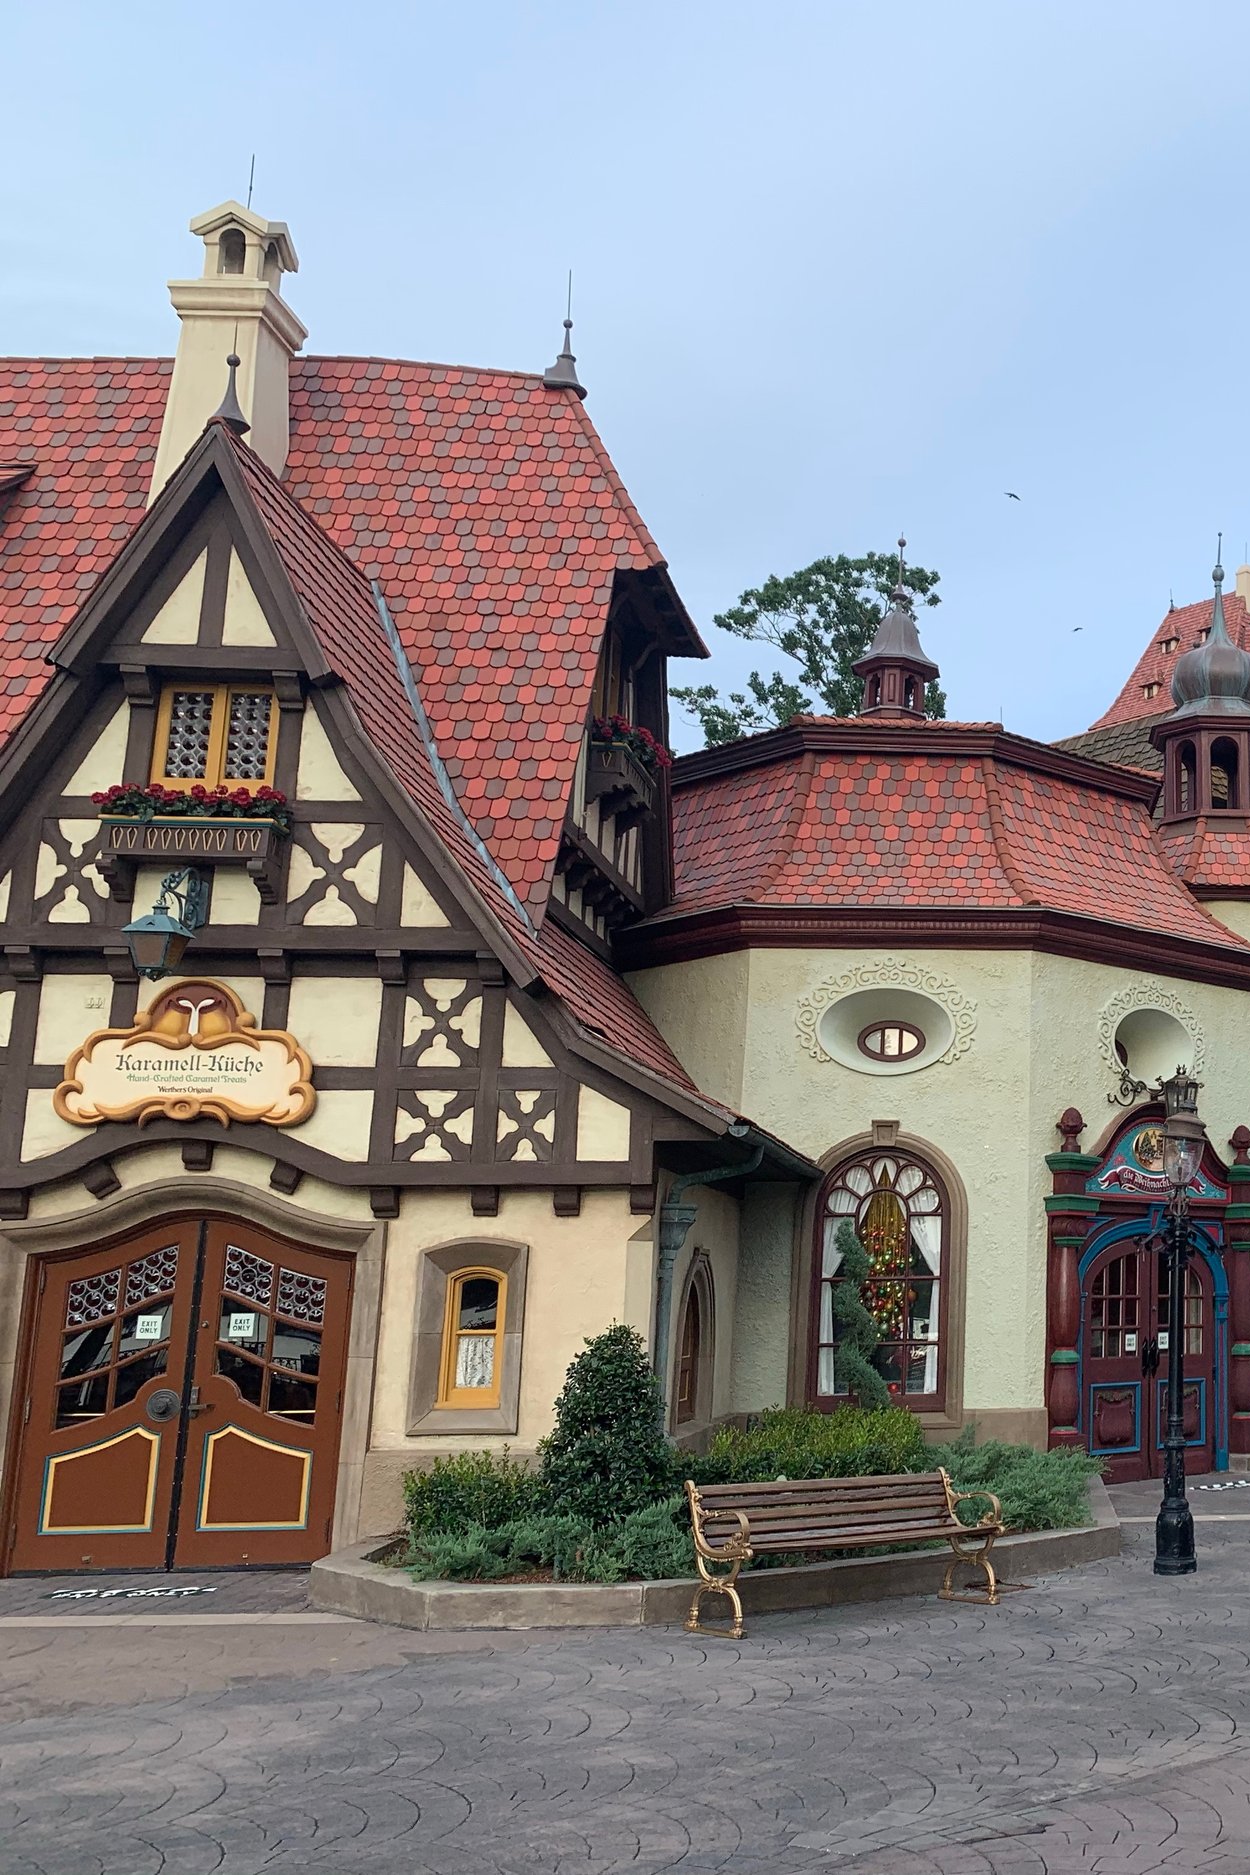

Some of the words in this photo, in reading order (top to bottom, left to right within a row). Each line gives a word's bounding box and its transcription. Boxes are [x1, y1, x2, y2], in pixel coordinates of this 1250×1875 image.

[115, 1054, 264, 1076] Karamell-Küche
[126, 1073, 184, 1083] Hand-Crafted
[185, 1074, 220, 1083] Caramel
[220, 1074, 247, 1084] Treats
[157, 1085, 187, 1094] Werthers
[187, 1085, 213, 1095] Original
[1134, 1172, 1172, 1188] Weihnacht
